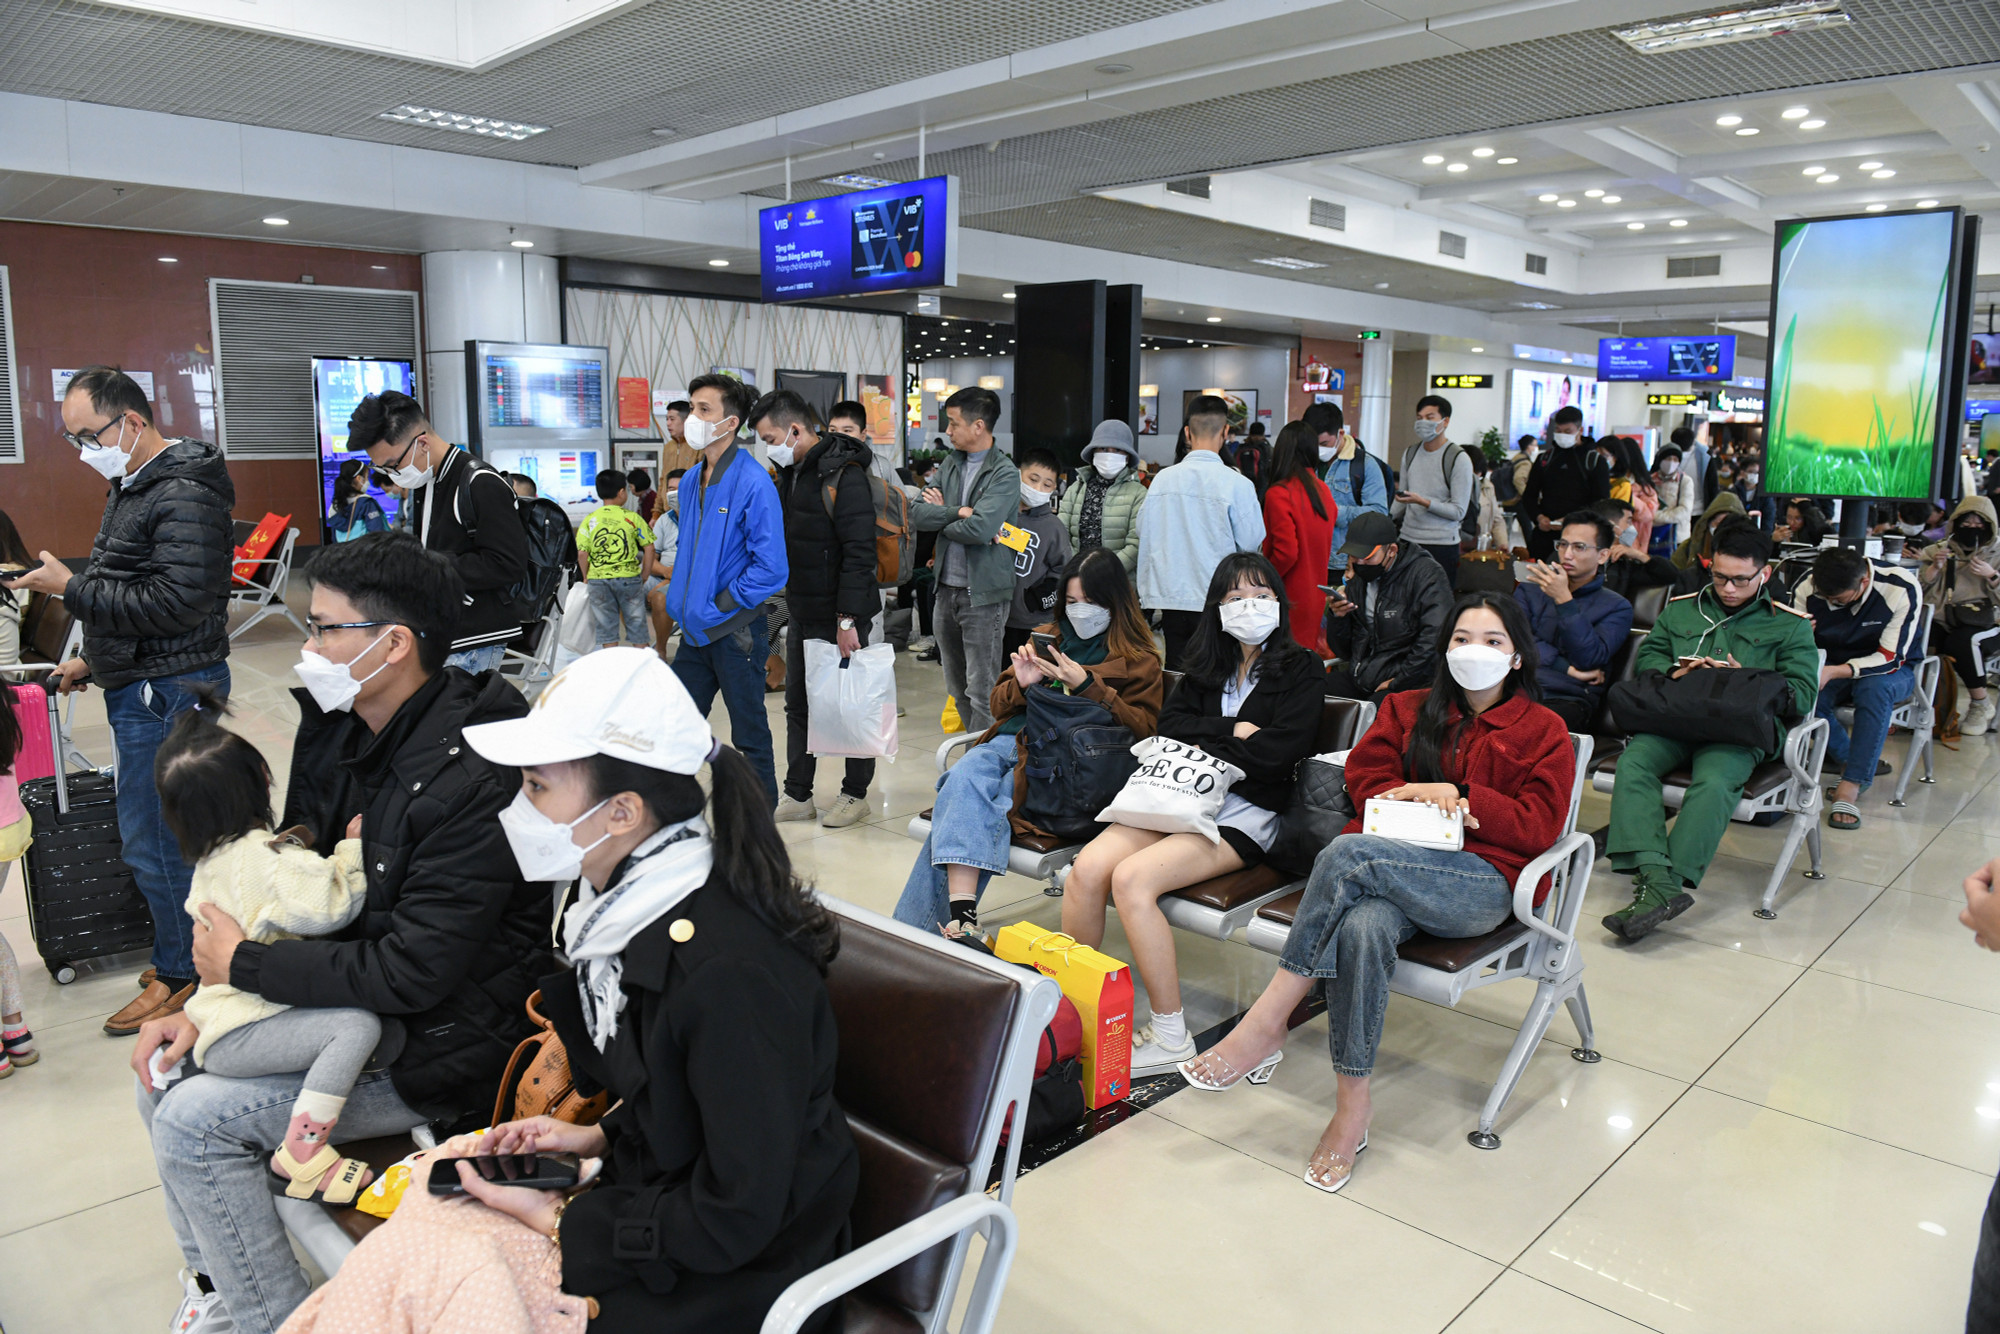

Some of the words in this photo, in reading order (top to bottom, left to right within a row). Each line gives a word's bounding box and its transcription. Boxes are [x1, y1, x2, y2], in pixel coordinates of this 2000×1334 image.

[903, 204, 917, 215] VIB
[774, 218, 789, 231] VIB
[1149, 780, 1160, 788] for
[1162, 783, 1181, 791] your
